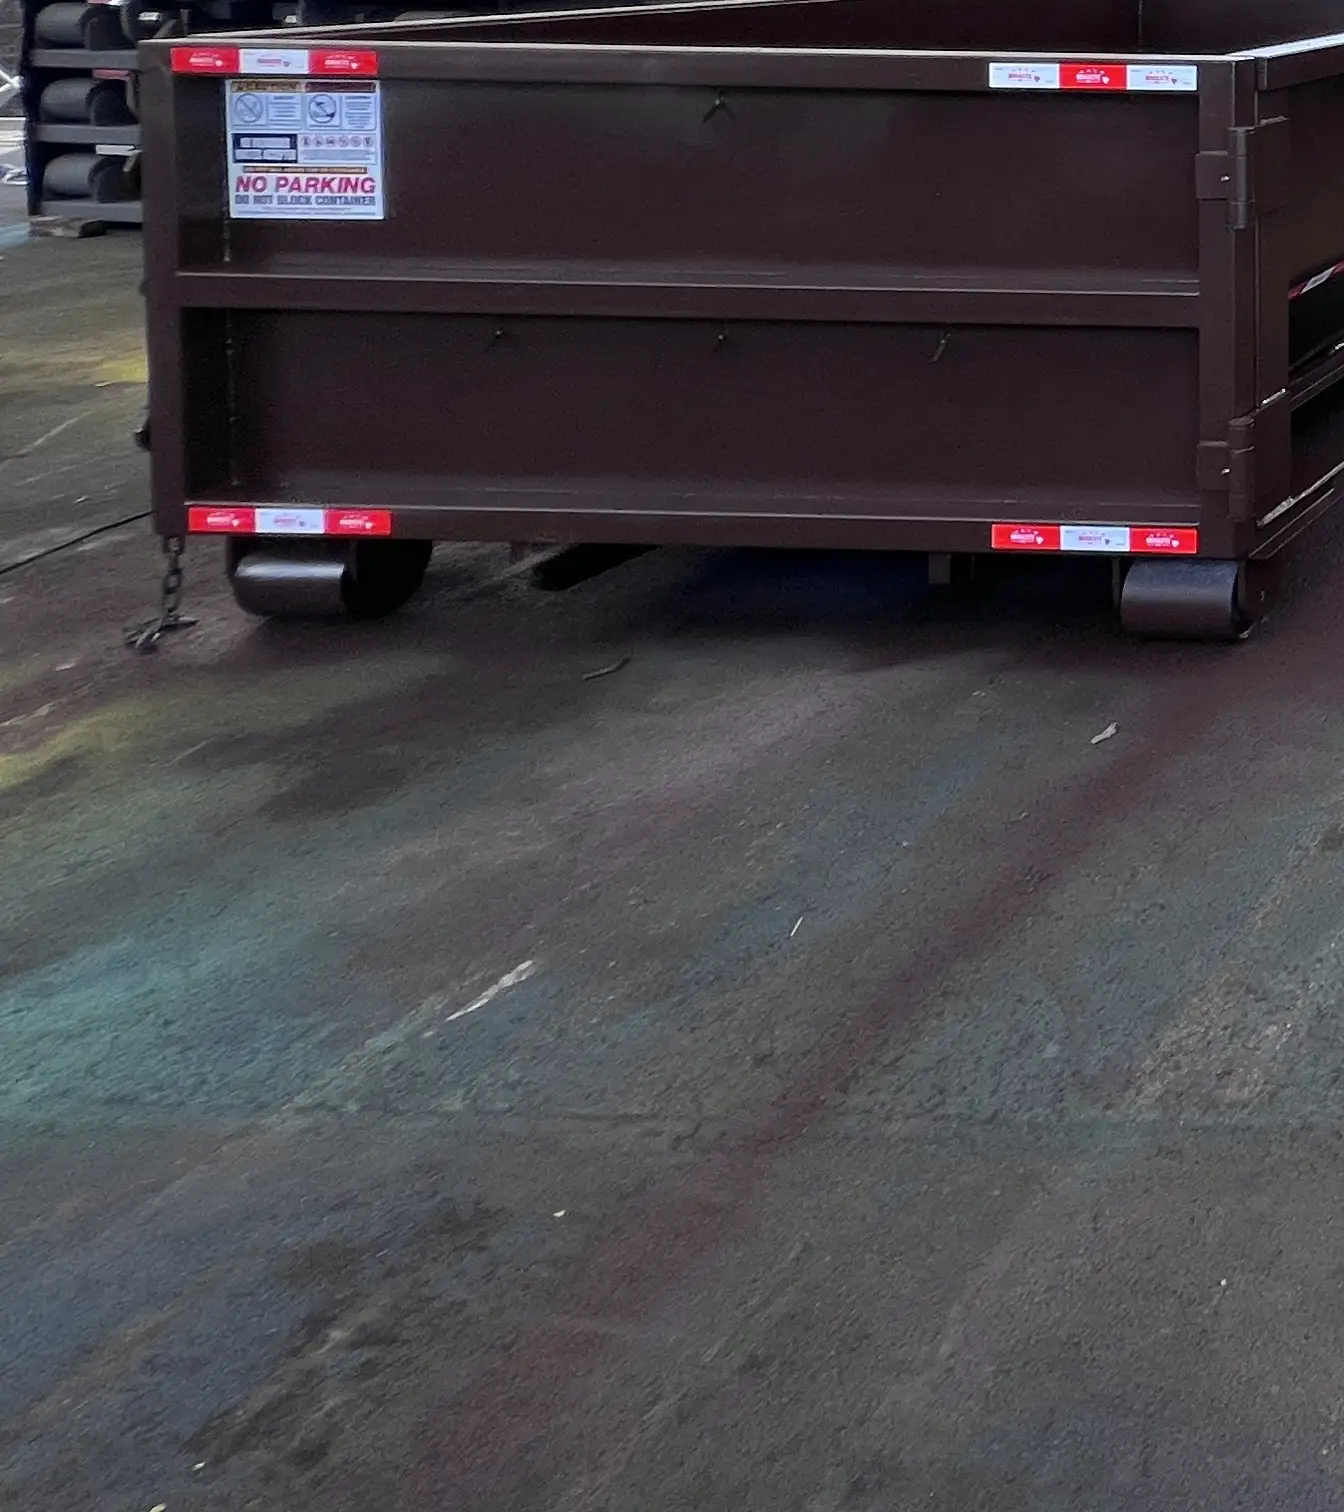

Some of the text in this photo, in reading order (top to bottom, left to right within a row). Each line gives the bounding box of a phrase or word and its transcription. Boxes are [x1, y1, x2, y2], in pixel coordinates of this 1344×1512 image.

[236, 176, 376, 193] NO PARKING
[253, 195, 273, 205] NOT
[315, 196, 376, 205] CONTAINER
